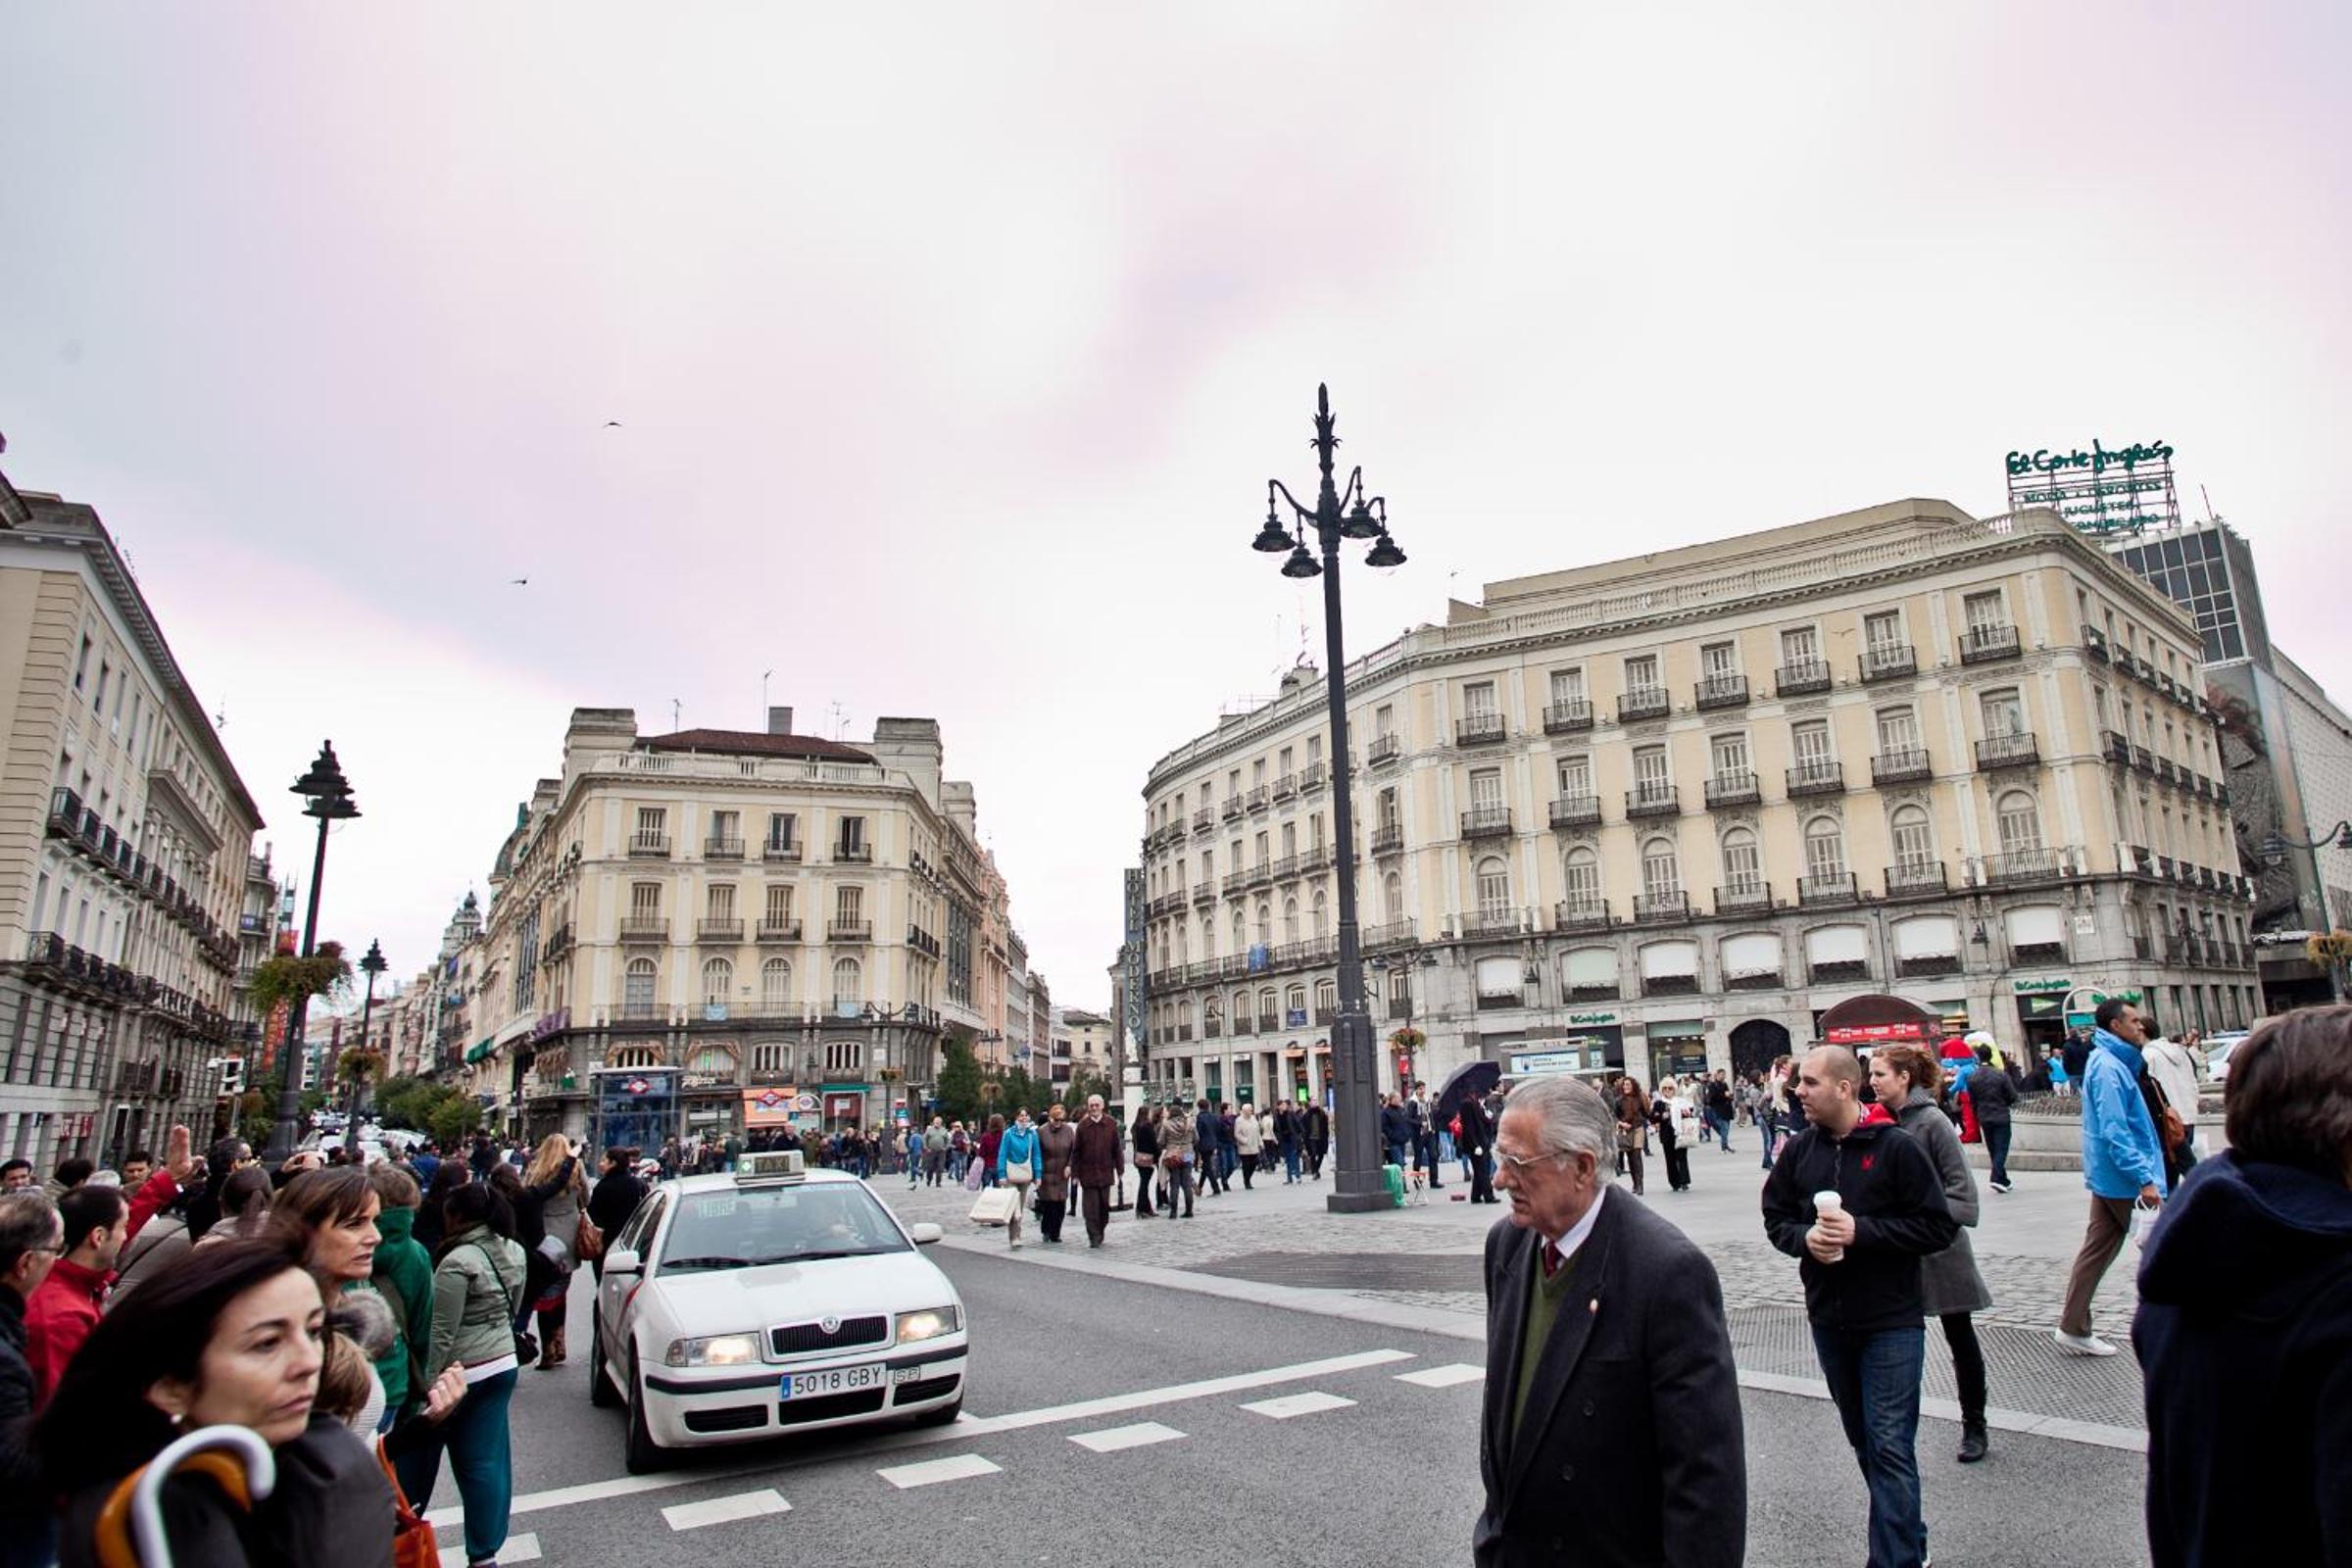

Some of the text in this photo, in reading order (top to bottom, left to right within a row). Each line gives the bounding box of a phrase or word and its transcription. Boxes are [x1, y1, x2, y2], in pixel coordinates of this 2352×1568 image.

[2034, 449, 2090, 471] Corte
[1127, 941, 1141, 1028] MODERNO
[757, 1156, 790, 1173] TAXI
[699, 1199, 735, 1217] LIBRE
[794, 1367, 880, 1395] 5018 GBY
